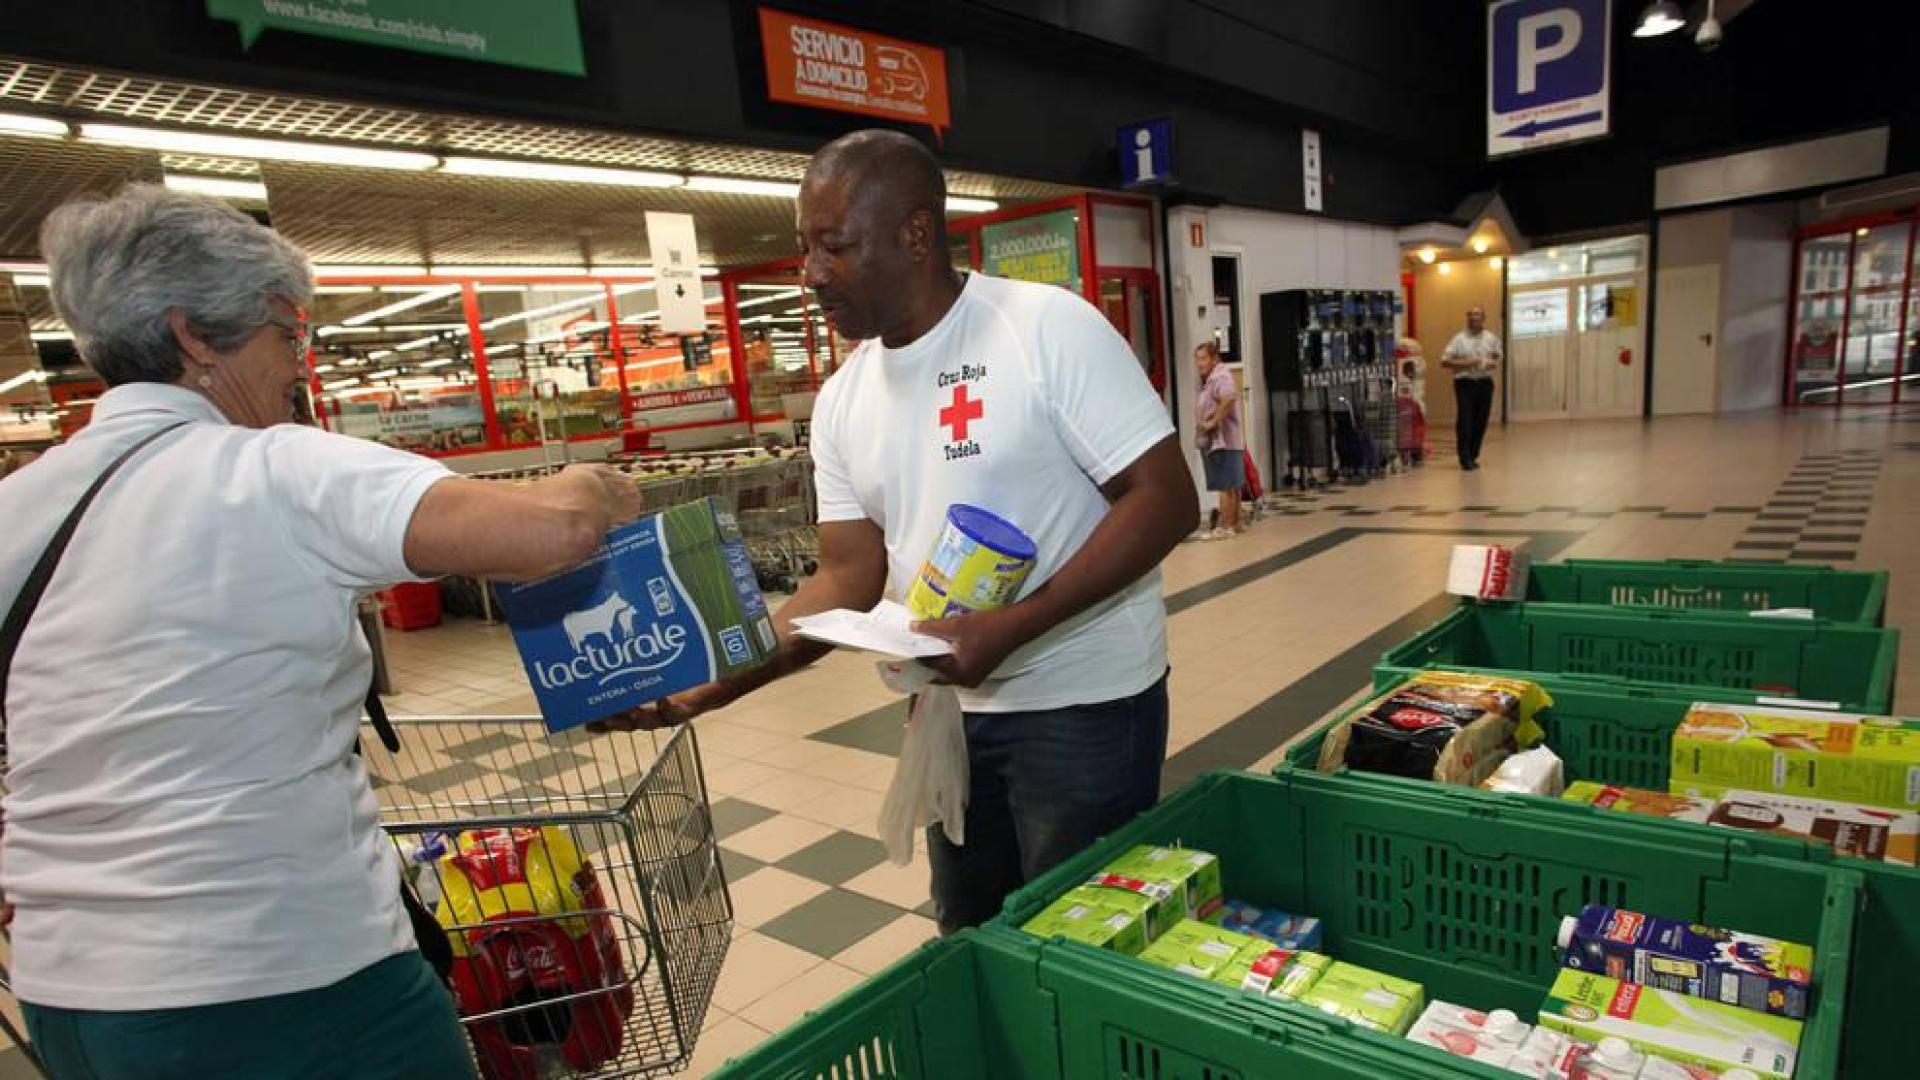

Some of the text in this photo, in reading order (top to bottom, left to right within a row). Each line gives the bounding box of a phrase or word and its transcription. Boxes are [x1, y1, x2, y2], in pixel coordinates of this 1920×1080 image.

[791, 25, 864, 66] SERVICIO
[1517, 8, 1582, 94] P
[796, 57, 806, 80] A
[806, 60, 868, 92] DOMICILIO
[1133, 128, 1155, 181] i
[938, 364, 986, 388] Cruz Roja
[944, 440, 981, 461] Tudela
[534, 622, 687, 690] lacturale
[588, 686, 628, 706] ENTERA
